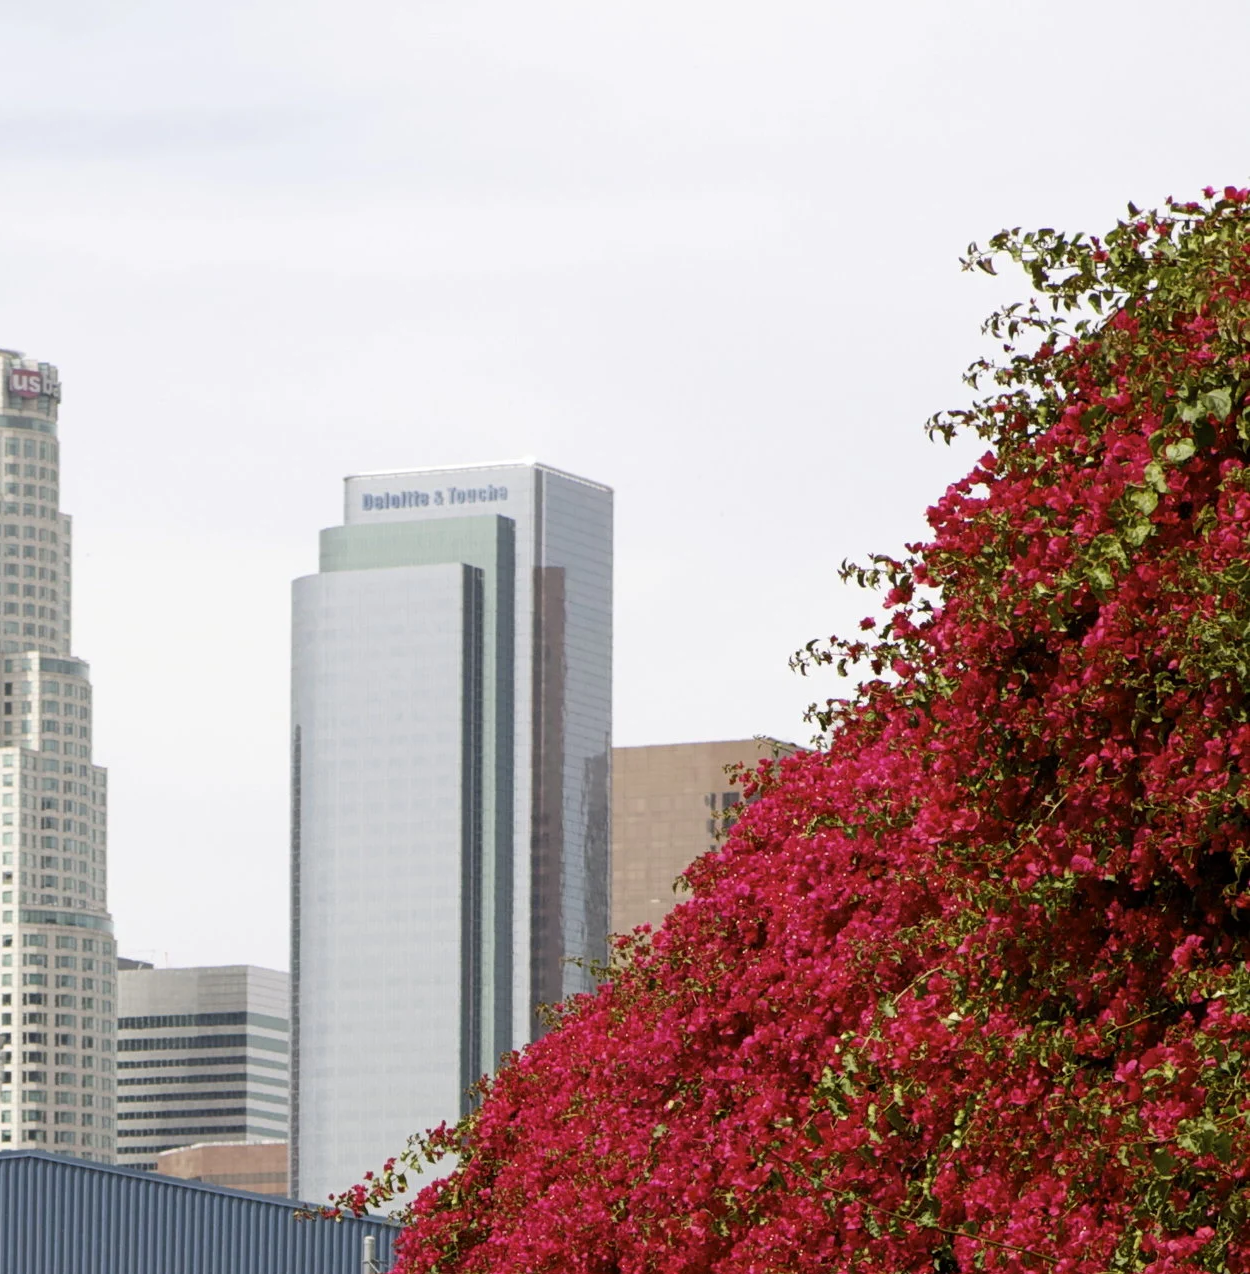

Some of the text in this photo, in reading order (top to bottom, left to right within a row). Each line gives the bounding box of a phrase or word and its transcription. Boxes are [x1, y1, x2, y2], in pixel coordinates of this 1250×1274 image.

[362, 484, 508, 511] Deloitte & Touche
